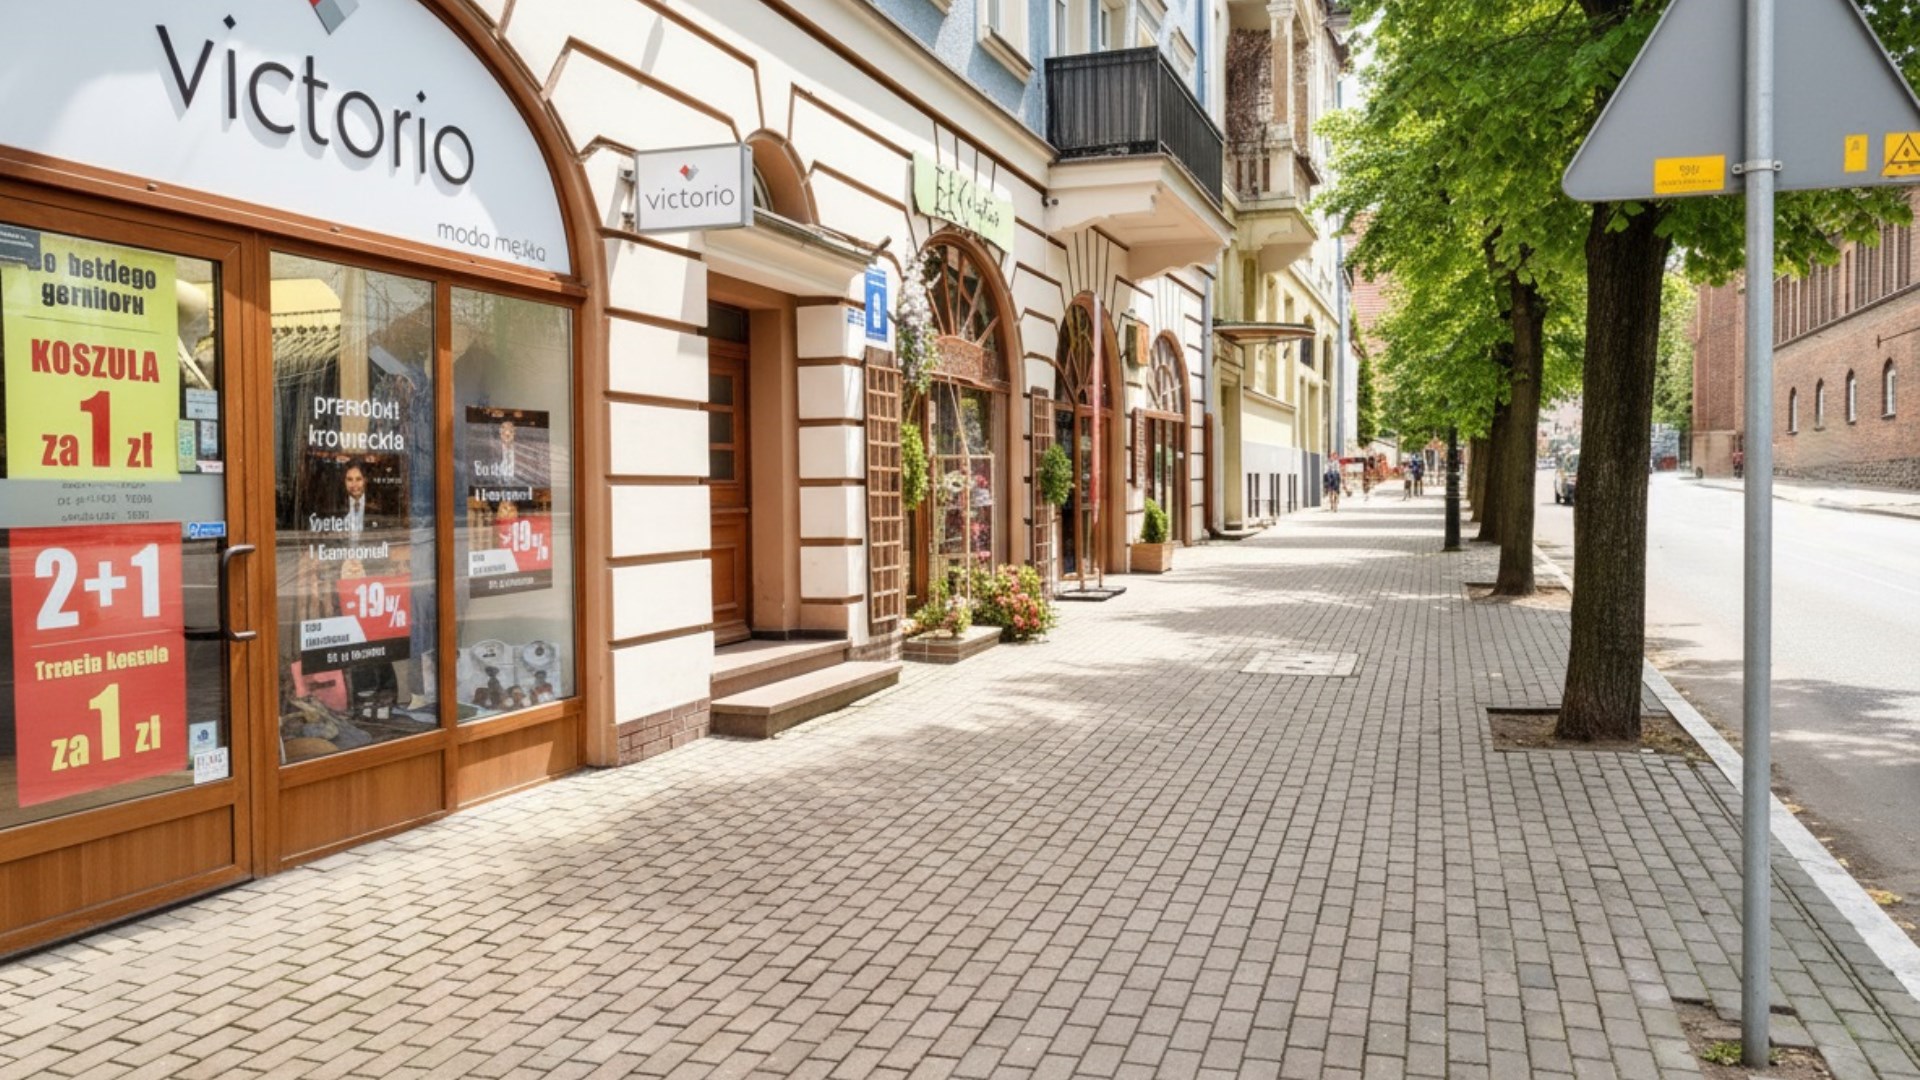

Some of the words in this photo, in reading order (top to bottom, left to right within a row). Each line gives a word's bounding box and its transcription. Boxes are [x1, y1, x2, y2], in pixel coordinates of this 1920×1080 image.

[645, 184, 735, 210] victorio
[31, 338, 160, 383] KOSZULA
[41, 434, 79, 467] za
[80, 390, 111, 467] 1
[35, 543, 161, 631] 2+1
[51, 733, 89, 772] za
[89, 683, 121, 761] 1
